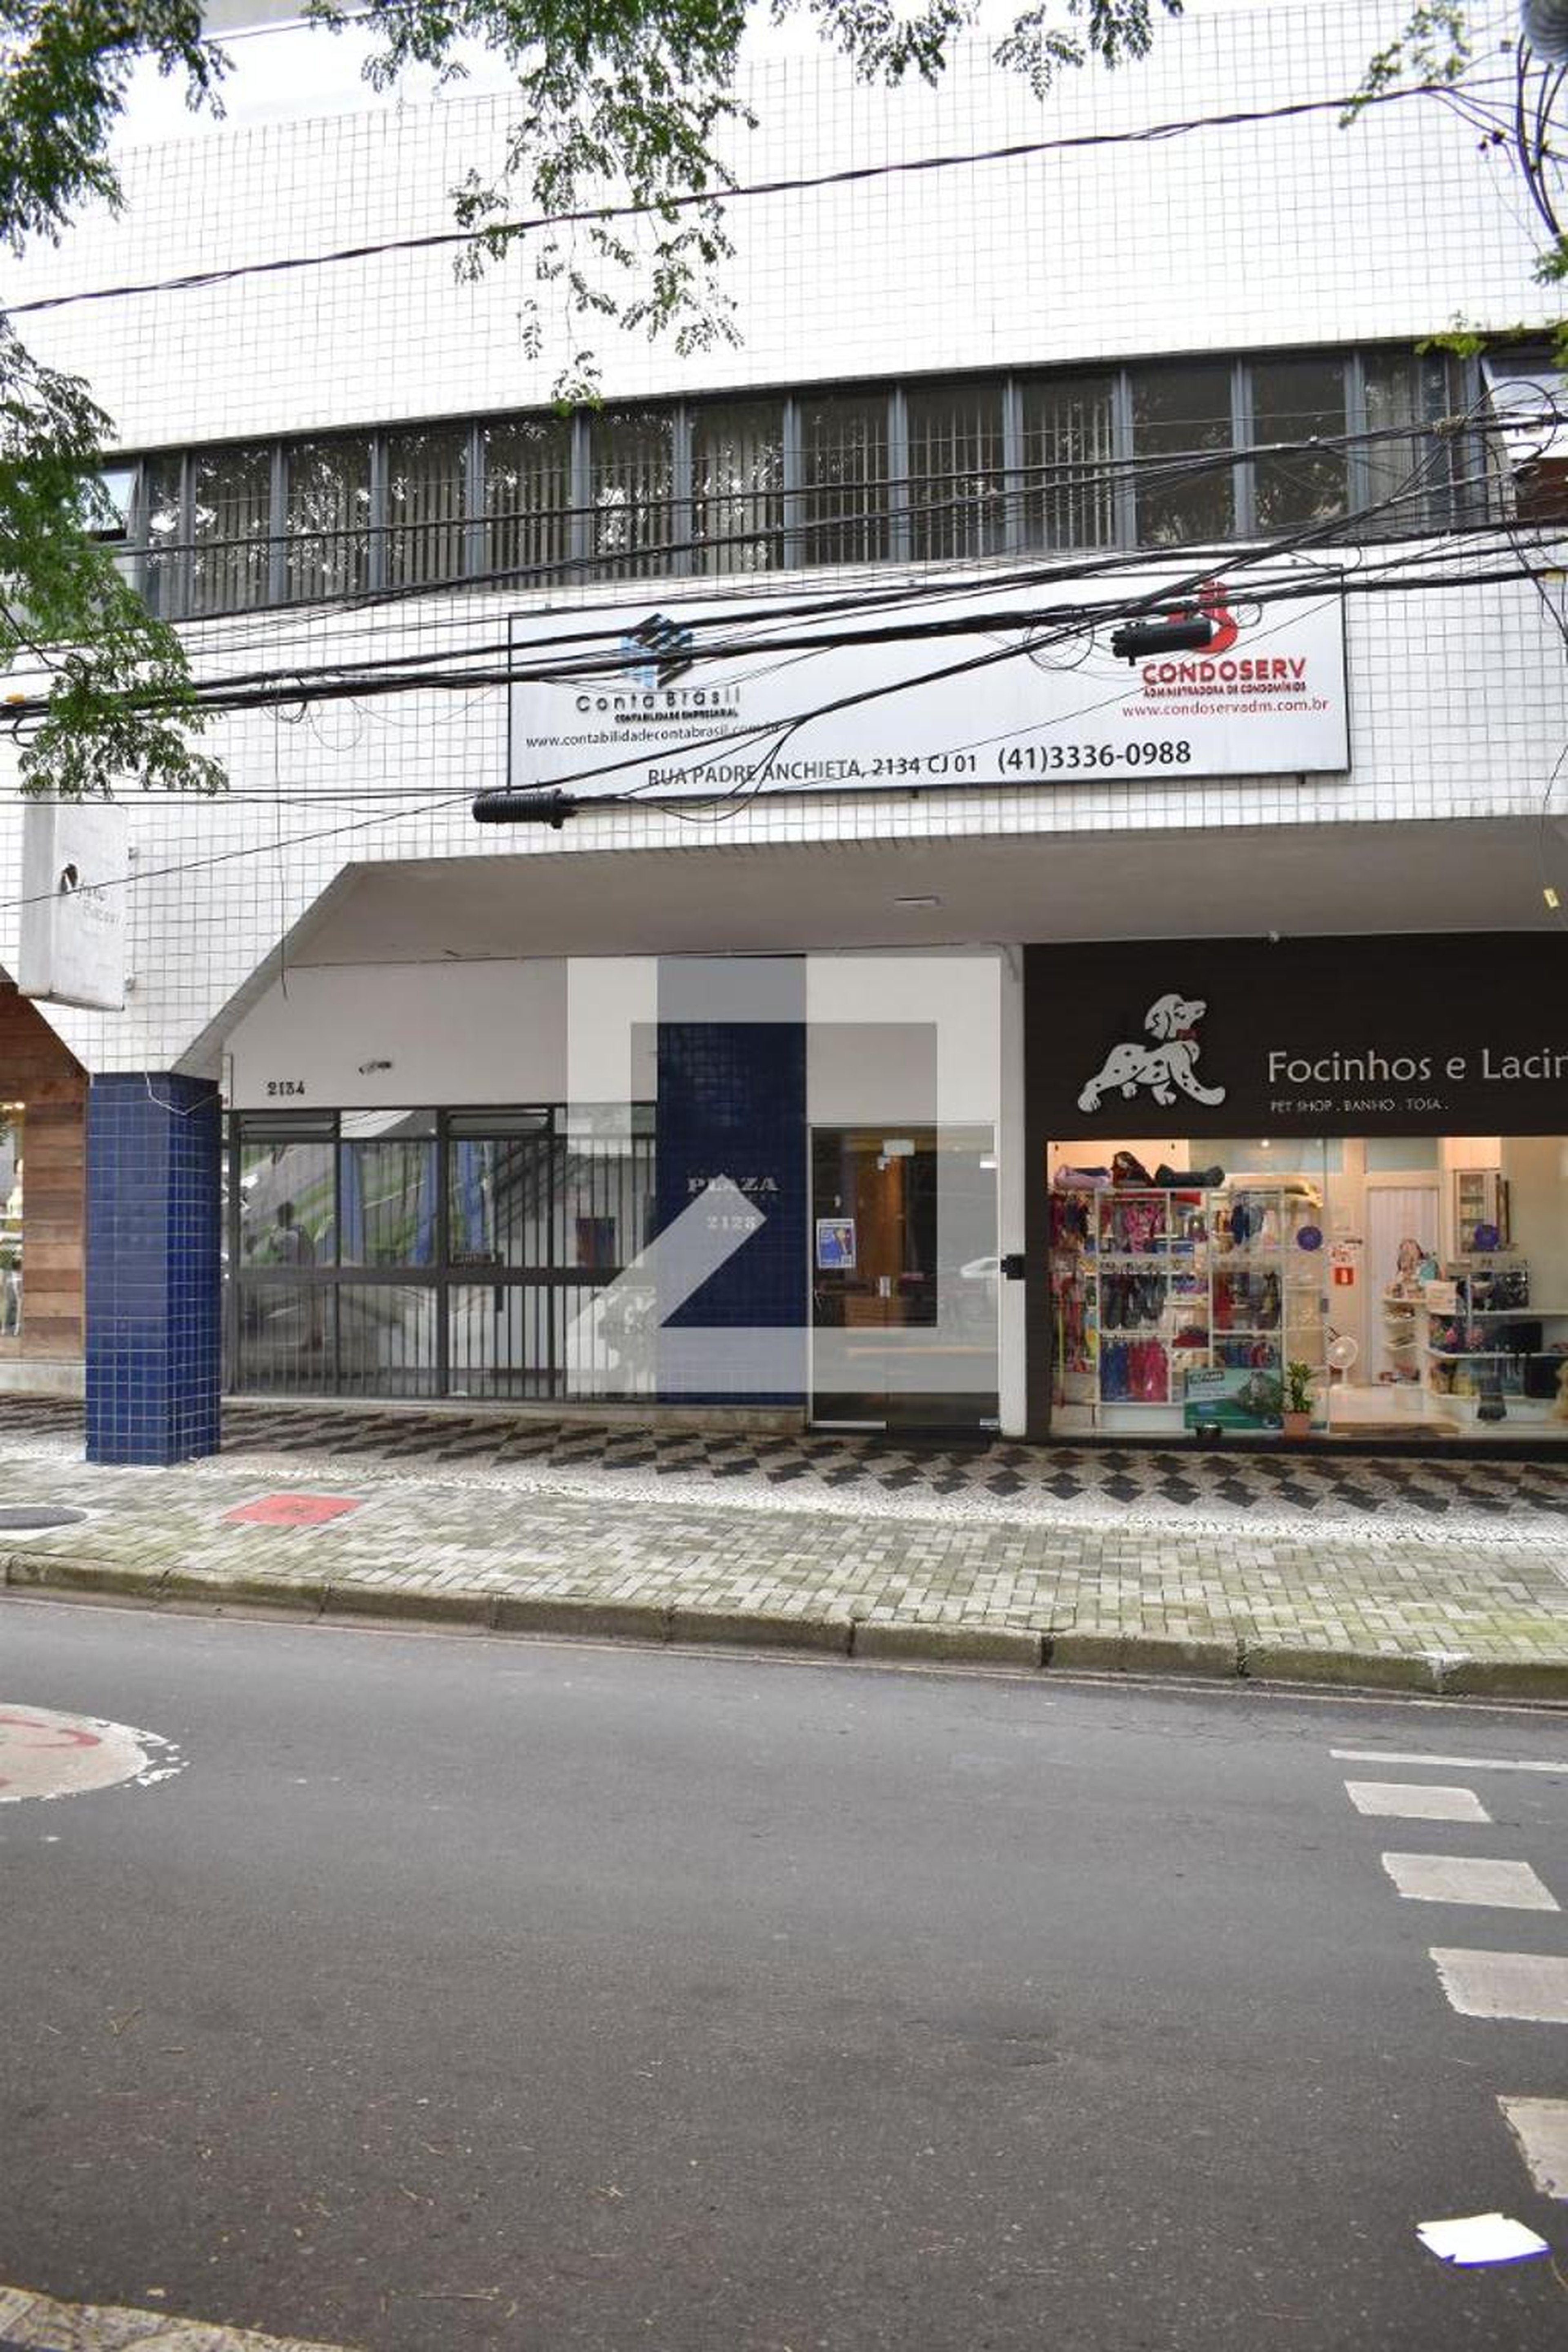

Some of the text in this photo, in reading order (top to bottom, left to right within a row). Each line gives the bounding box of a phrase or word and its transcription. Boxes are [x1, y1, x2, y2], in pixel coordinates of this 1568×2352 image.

[1143, 658, 1305, 685] CONDOSERV
[576, 686, 739, 711] Conta Brasil
[1122, 698, 1329, 717] www.condoservadm.com.br
[648, 740, 1191, 786] RUA PADRE ANCHIETA, 2134 CJ 01 (41)3336-0988
[1268, 1049, 1432, 1083] Focinhos
[1446, 1056, 1467, 1079] e
[267, 1080, 305, 1095] 2134
[1271, 1100, 1292, 1111] PET
[1297, 1099, 1332, 1112] SHOP
[1345, 1099, 1396, 1111] BANHO
[687, 1176, 780, 1192] PLAZA
